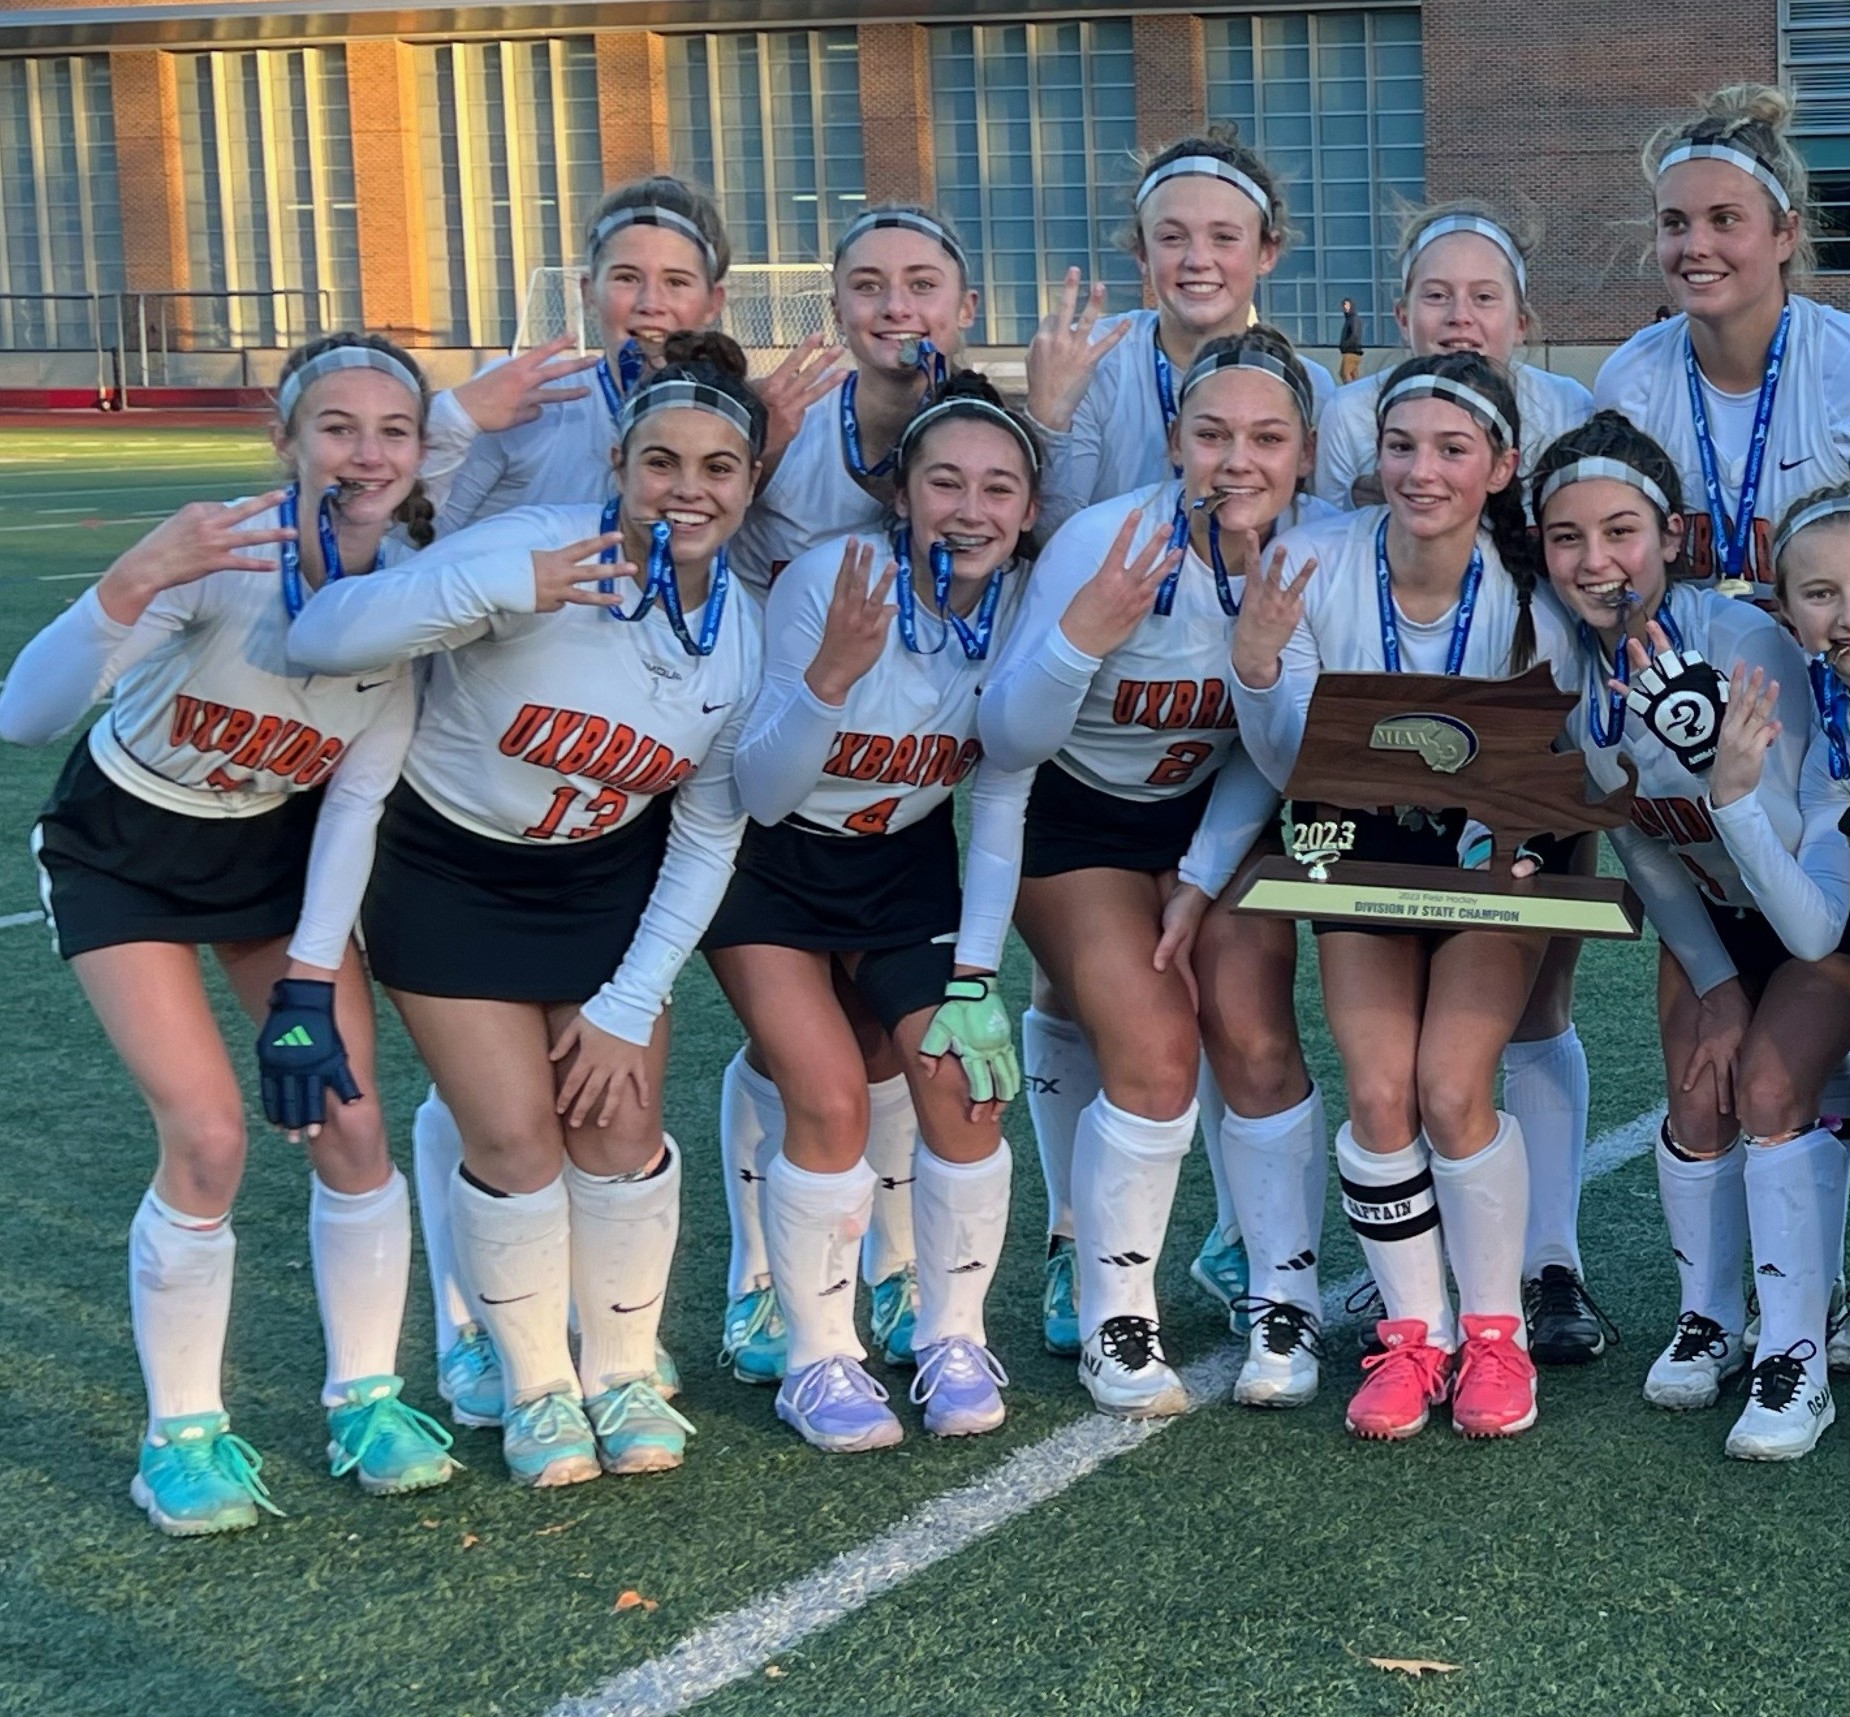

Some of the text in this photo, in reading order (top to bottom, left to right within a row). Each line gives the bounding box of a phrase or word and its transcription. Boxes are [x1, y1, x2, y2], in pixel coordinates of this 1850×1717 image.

[499, 704, 698, 795] UXBRIDG
[1376, 730, 1428, 745] MIAA
[822, 732, 984, 788] XBRIDG
[1145, 741, 1214, 785] 2
[1293, 821, 1355, 851] 2023
[1355, 901, 1519, 922] DIVISION IV STATE CHAMPION
[1348, 1199, 1412, 1220] CAPTAIN
